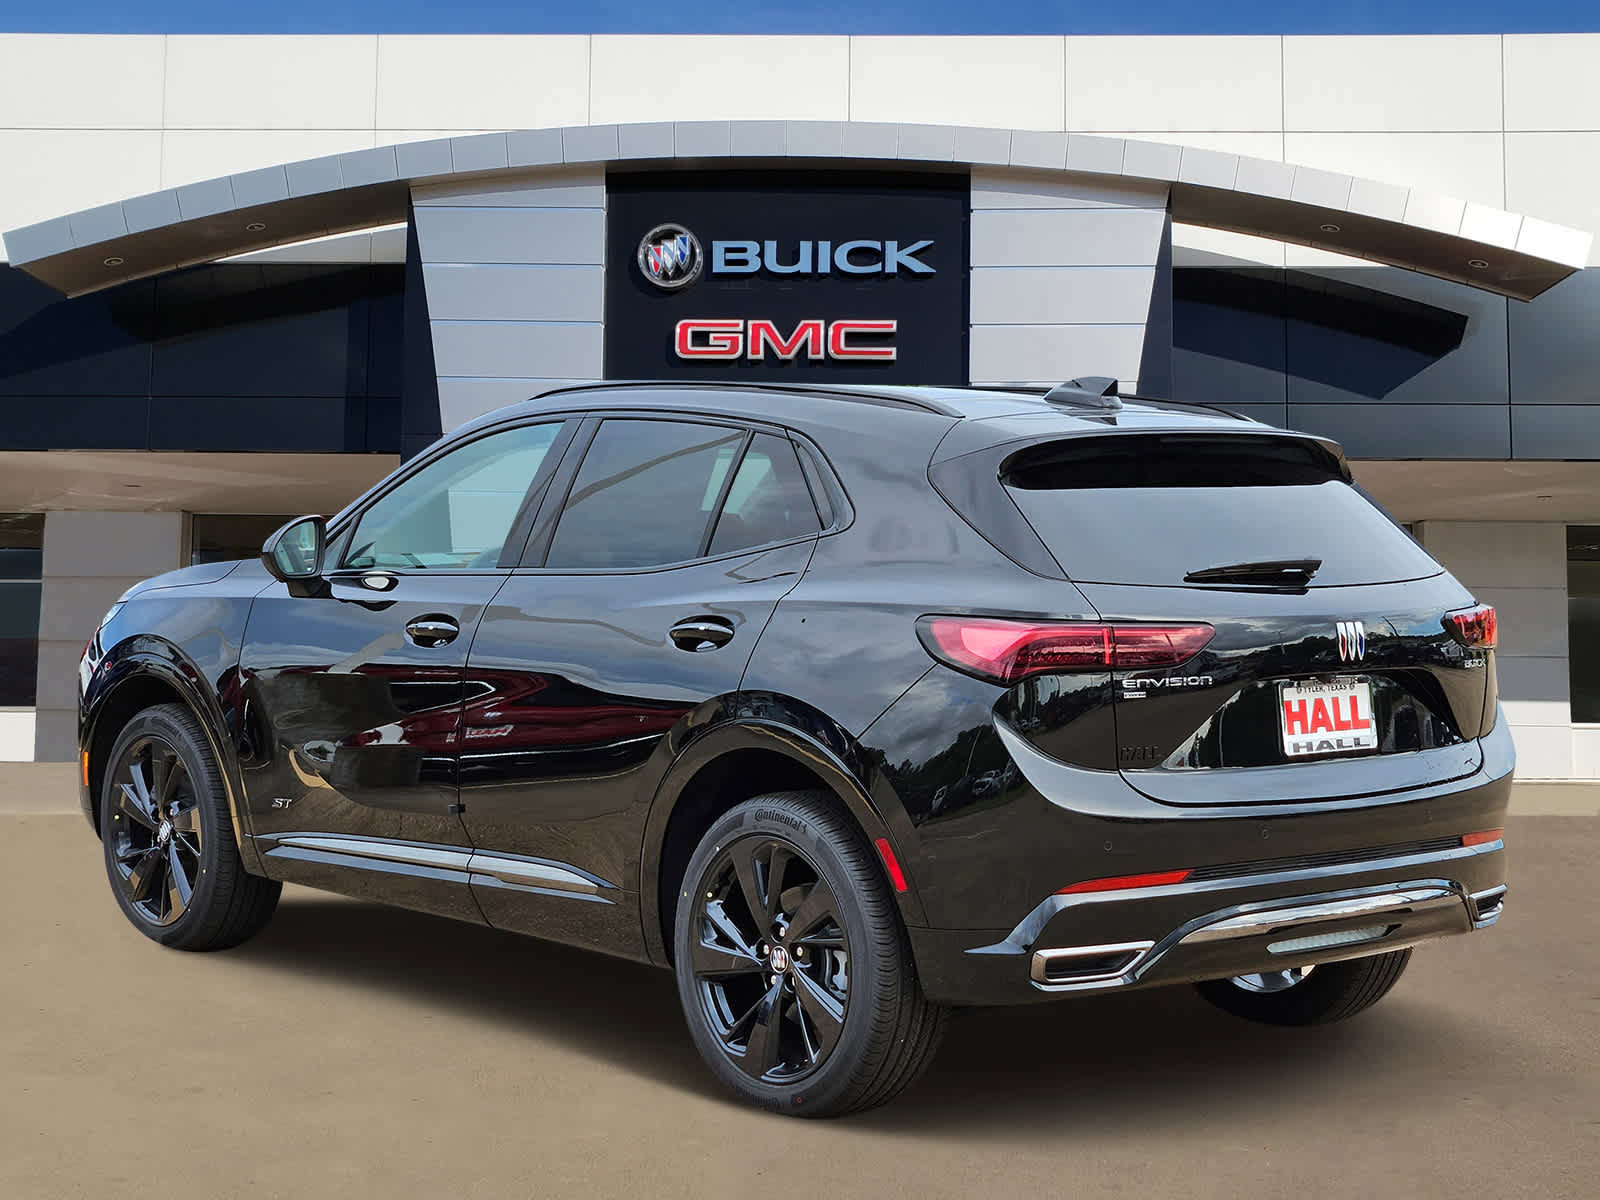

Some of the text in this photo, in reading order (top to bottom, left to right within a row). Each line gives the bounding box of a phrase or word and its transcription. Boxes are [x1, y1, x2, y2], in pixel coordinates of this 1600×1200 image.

[712, 240, 936, 273] BUICK
[675, 319, 897, 360] GMC
[1284, 696, 1370, 735] HALL
[1293, 738, 1370, 753] HALL
[271, 798, 293, 809] ST
[754, 808, 802, 831] Continental
